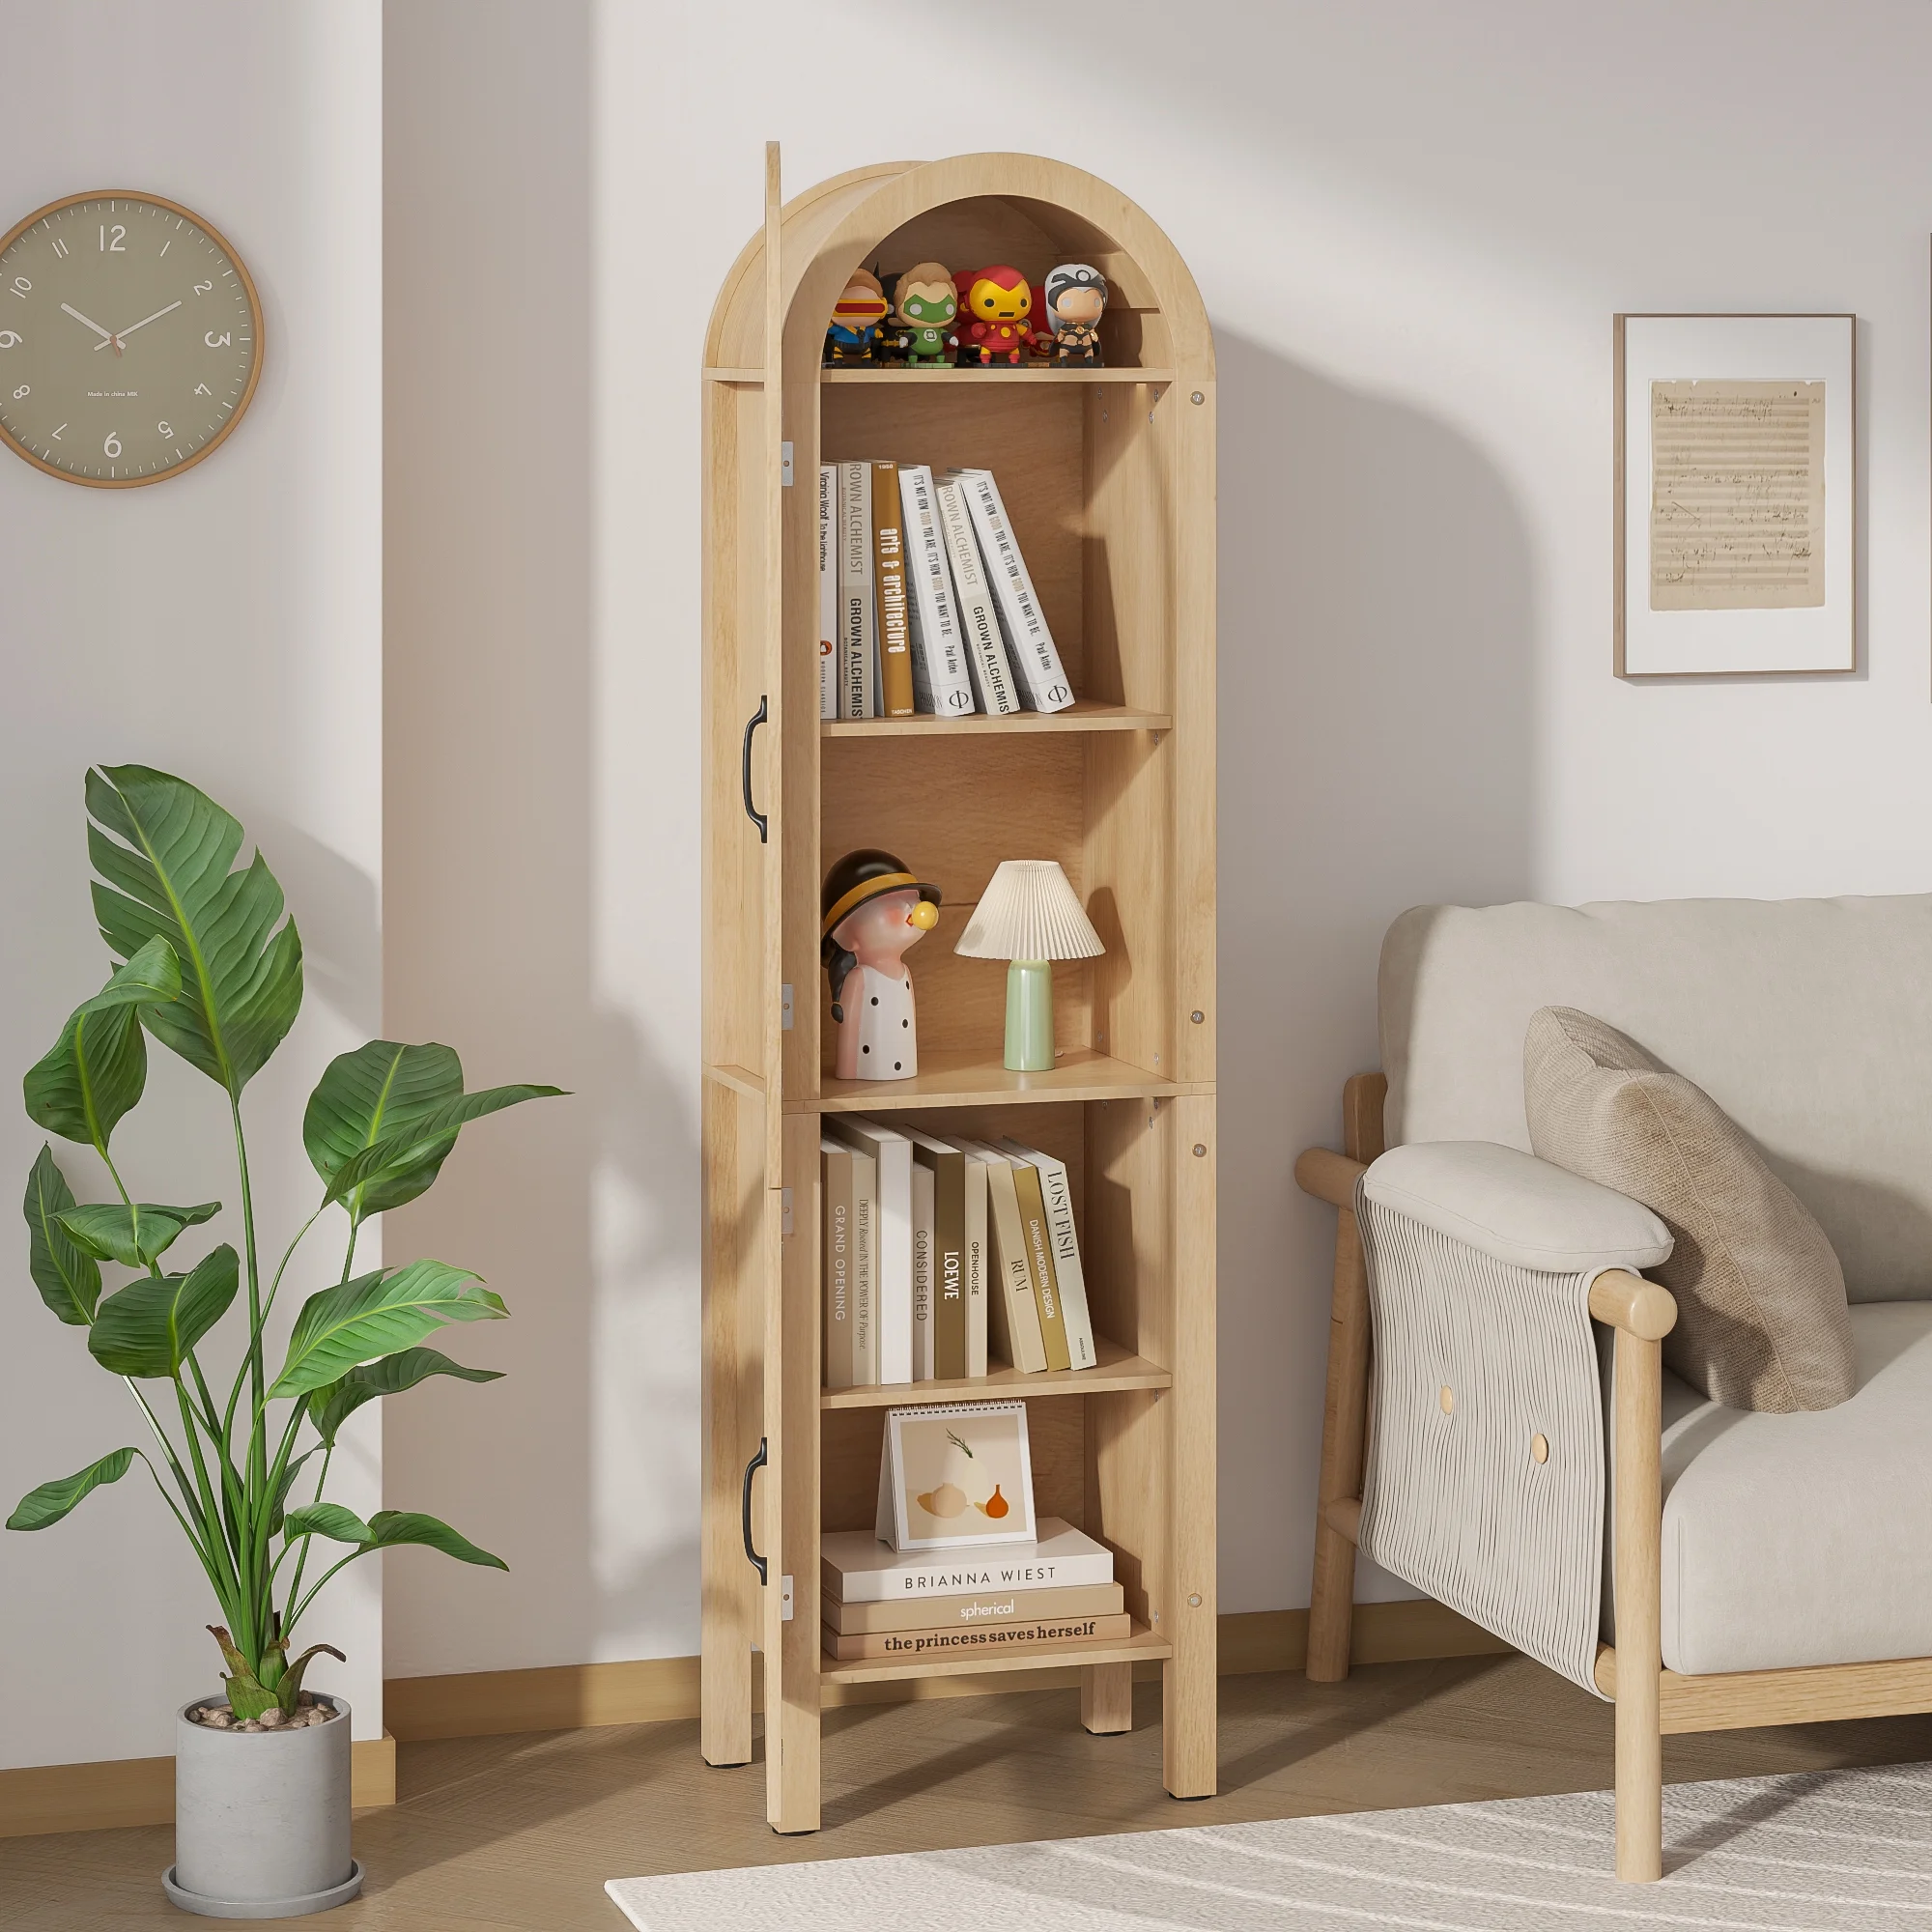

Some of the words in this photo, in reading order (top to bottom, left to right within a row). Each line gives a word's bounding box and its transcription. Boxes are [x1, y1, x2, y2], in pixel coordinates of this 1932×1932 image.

[51, 239, 70, 259] 11
[99, 224, 127, 252] 12
[9, 276, 33, 299] 10
[192, 280, 213, 296] 2
[204, 330, 231, 348] 3
[13, 384, 31, 400] 8
[193, 383, 213, 397] 4
[51, 422, 69, 440] 7
[157, 420, 175, 440] 5
[103, 431, 123, 459] 6
[915, 486, 927, 498] NOT
[918, 498, 929, 510] HOW
[984, 503, 997, 516] HOW
[850, 505, 863, 575] ALCHEMIST
[879, 528, 901, 554] arts
[923, 526, 935, 539] YOU
[994, 530, 1007, 542] YOU
[952, 525, 979, 585] ALCHEMIST
[929, 563, 942, 576] HOW
[1007, 564, 1020, 578] HOW
[934, 591, 947, 603] YOU
[1016, 591, 1030, 604] YOU
[850, 598, 863, 647] GROWN
[882, 574, 907, 653] architecture
[937, 604, 950, 619] WANT
[1021, 604, 1035, 619] WANT
[1027, 618, 1037, 627] TO
[940, 619, 952, 630] TO
[973, 606, 994, 650] GROWN
[985, 654, 1010, 714] ALCHEMIS
[851, 651, 864, 719] ALCHEMIS
[1047, 1171, 1069, 1215] LOST
[859, 1199, 868, 1227] DEEPLY
[835, 1206, 845, 1253] GRAND
[859, 1229, 868, 1252] Rooted
[1029, 1219, 1042, 1252] DANISH
[1055, 1219, 1075, 1260] FISH
[859, 1253, 868, 1262] IN
[971, 1241, 980, 1295] OPENHOUSE
[859, 1263, 868, 1279] THE
[916, 1230, 928, 1321] CONSIDERED
[944, 1251, 959, 1300] LOEWE
[1010, 1259, 1028, 1293] RUM
[1036, 1251, 1049, 1290] MODERN
[835, 1259, 845, 1321] OPENING
[859, 1281, 868, 1308] POWER
[1041, 1288, 1055, 1319] DESIGN
[859, 1309, 868, 1321] OF
[904, 1572, 991, 1589] BRIANNA
[1001, 1567, 1057, 1582] WIEST
[960, 1598, 1014, 1620] spherical
[884, 1637, 913, 1651] the
[915, 1633, 987, 1652] princess
[988, 1628, 1035, 1643] saves
[1037, 1621, 1096, 1640] herself
